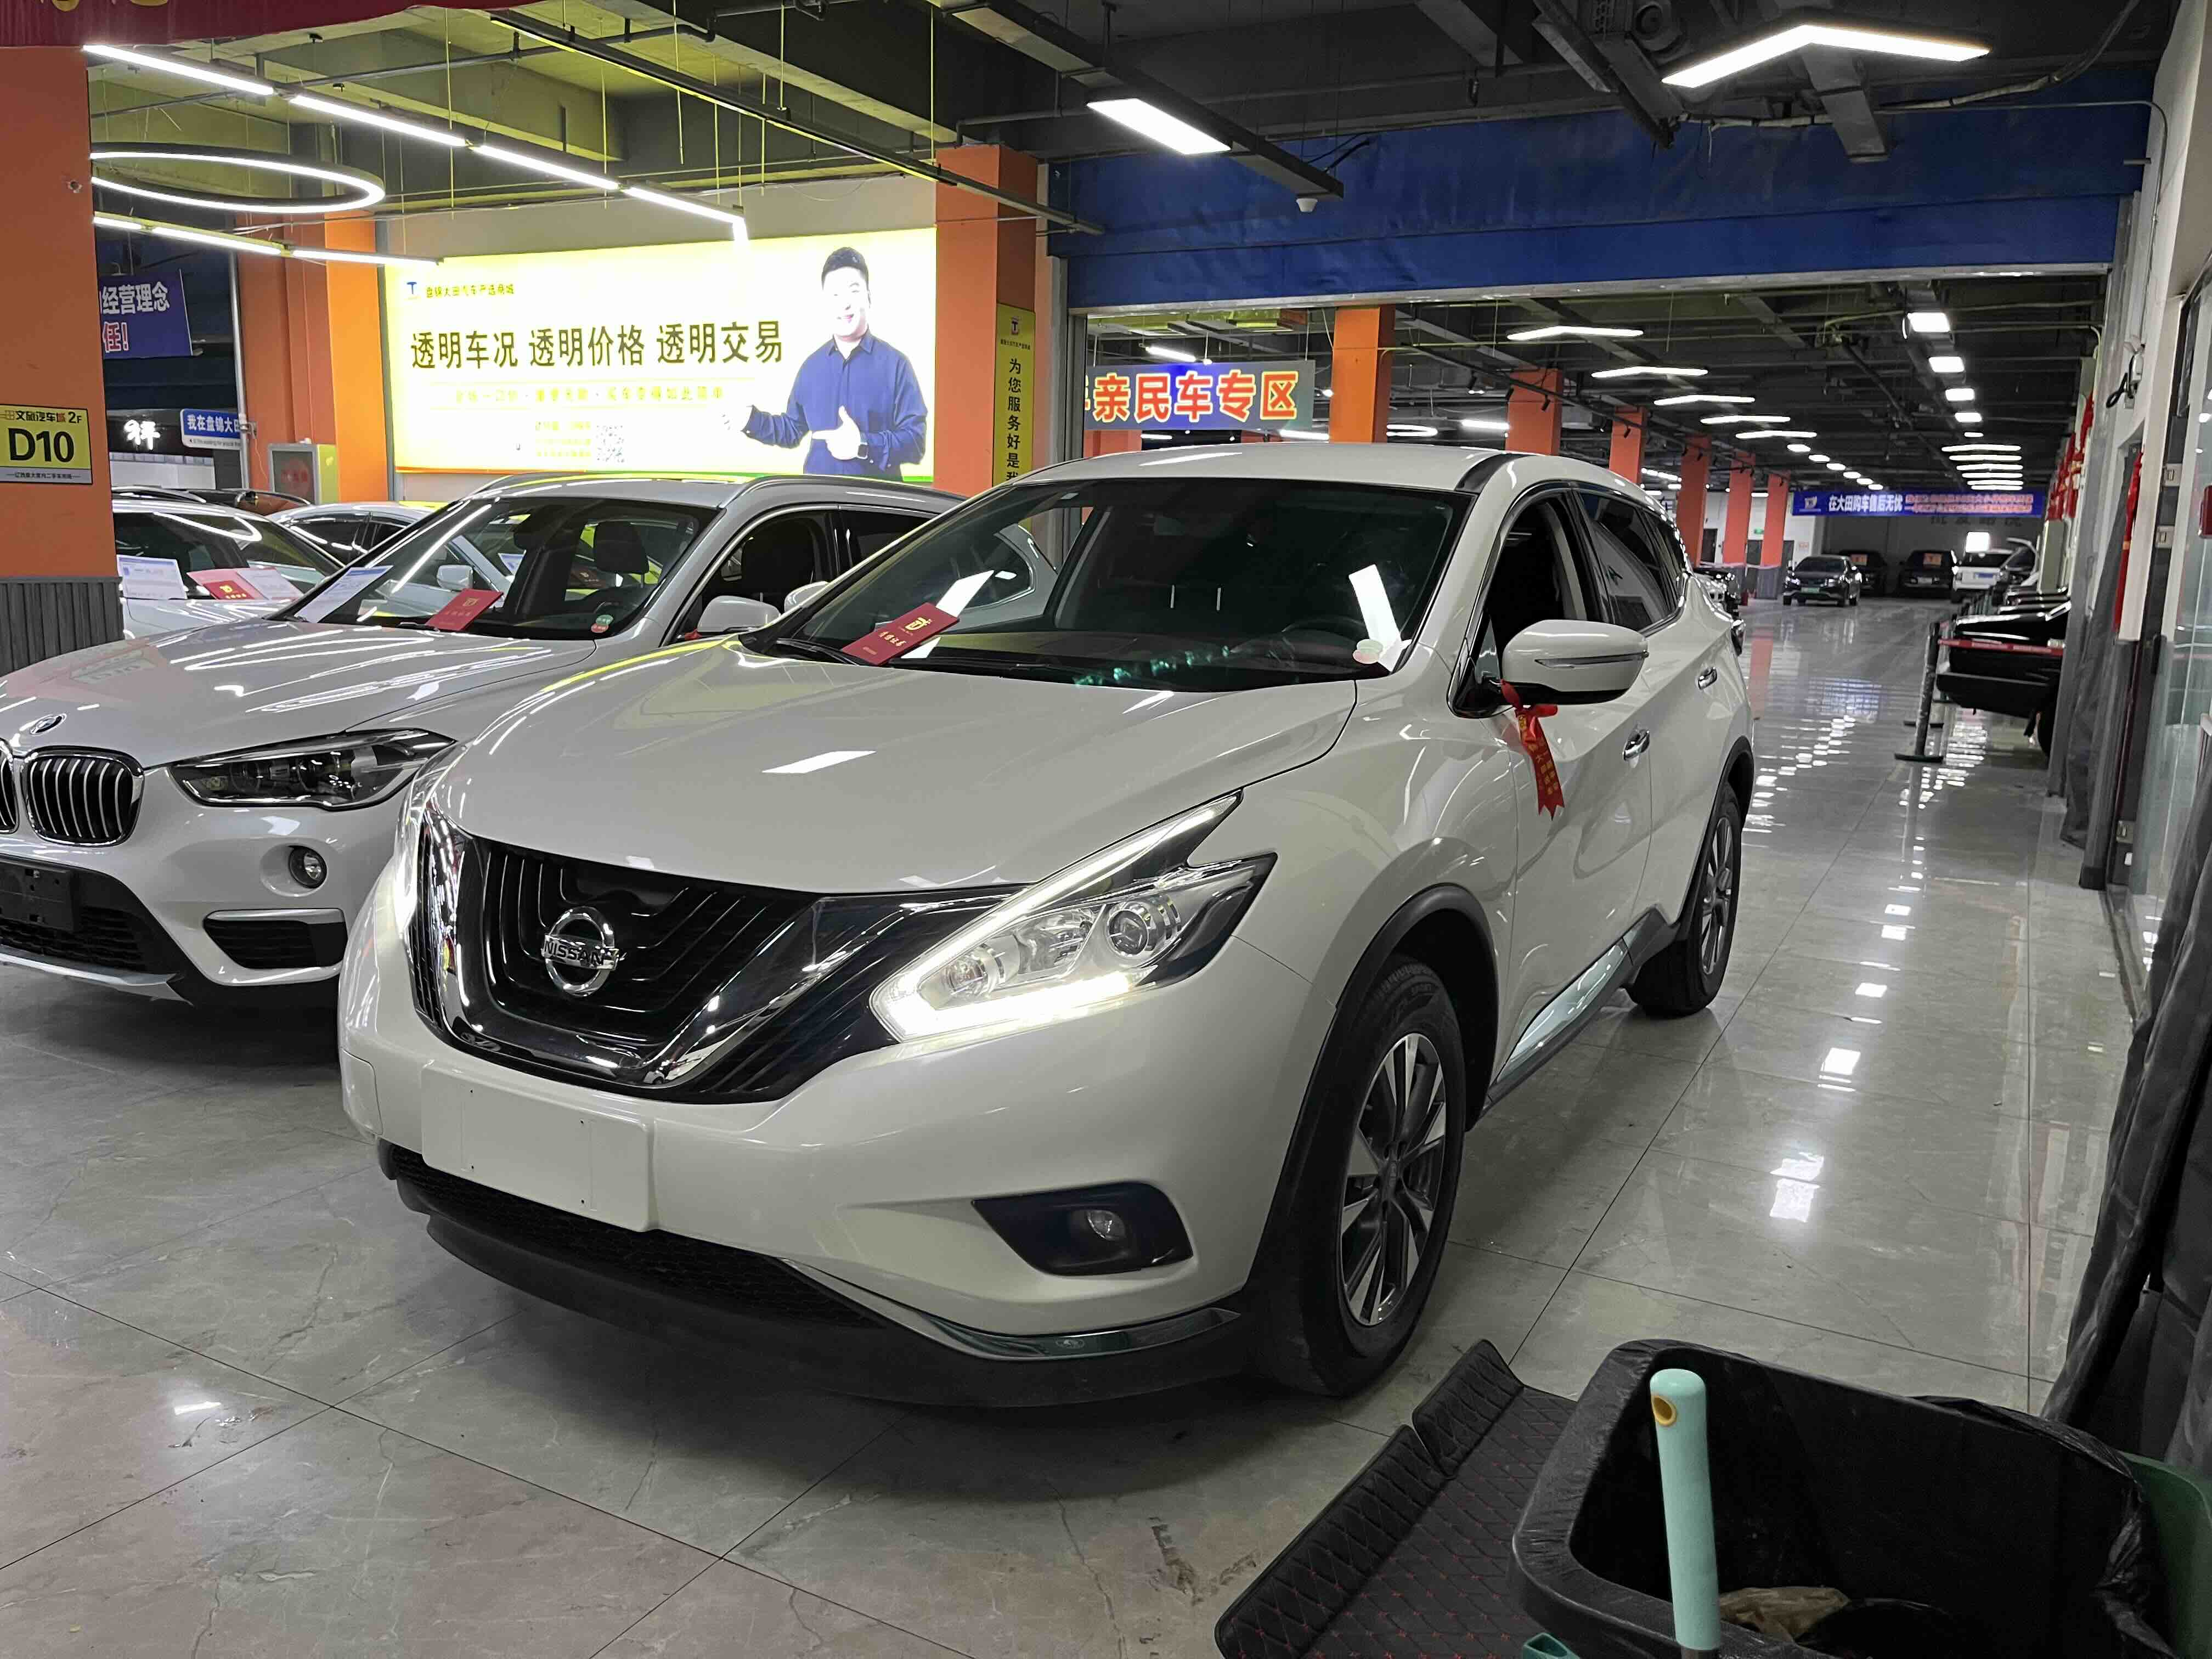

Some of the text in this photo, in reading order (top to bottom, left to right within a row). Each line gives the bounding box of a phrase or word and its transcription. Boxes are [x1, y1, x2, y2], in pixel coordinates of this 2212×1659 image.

[99, 281, 171, 315] 经营理念
[411, 320, 782, 370] 透明车况 透明价格 透明交易
[1085, 369, 1300, 424] 亲民车专区
[68, 411, 82, 424] 2F
[8, 427, 75, 463] D10
[544, 939, 603, 967] NISSAN
